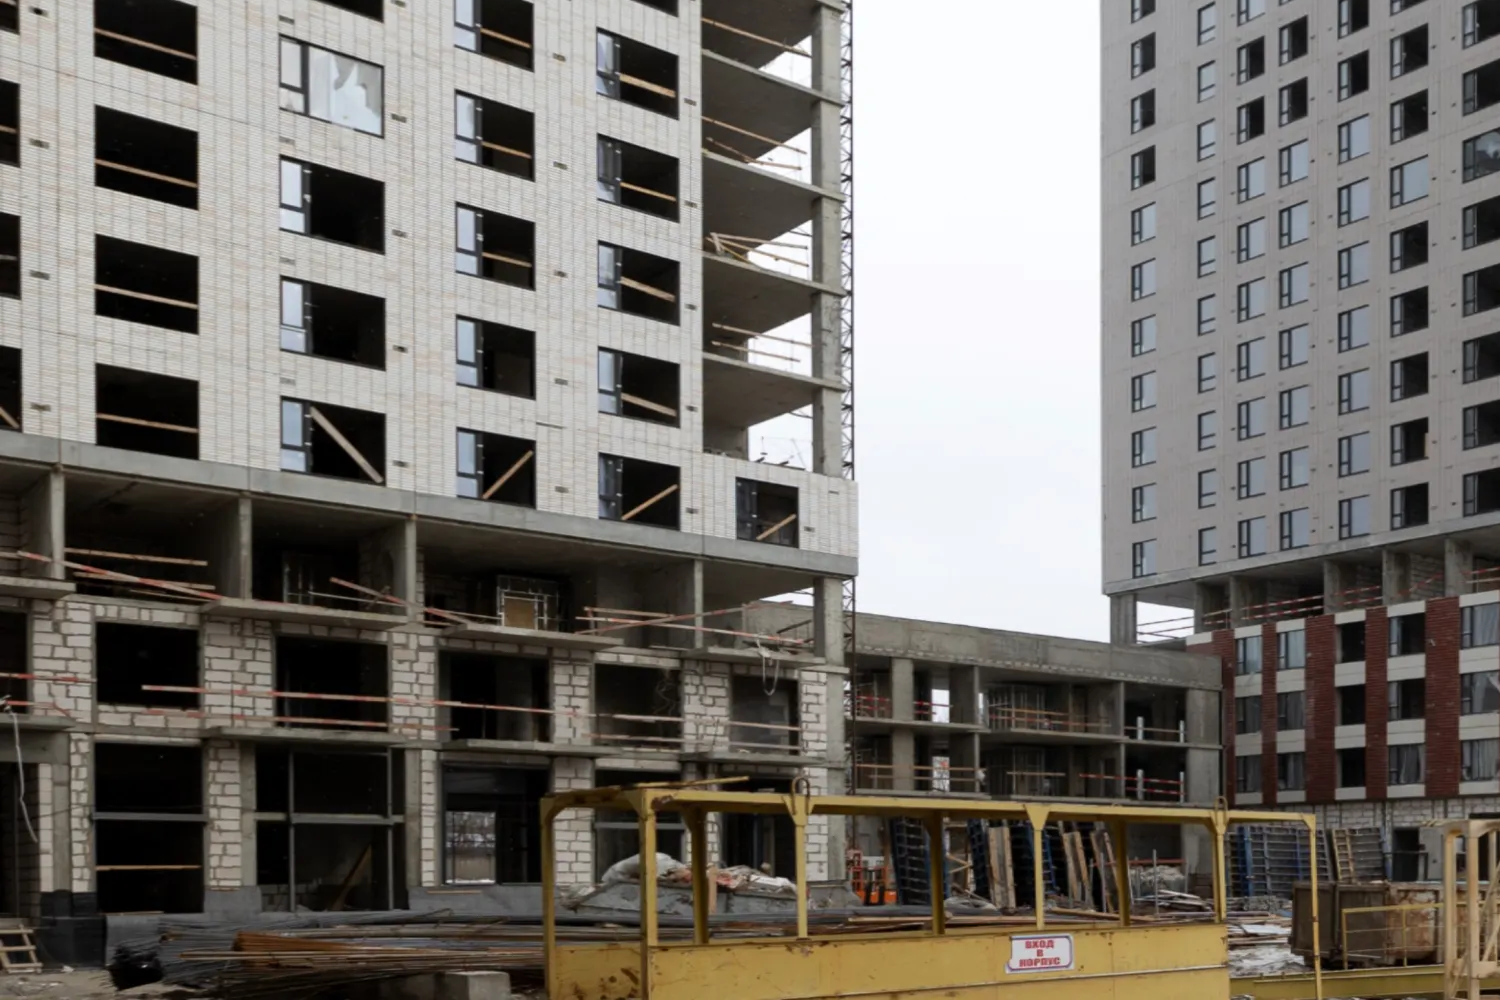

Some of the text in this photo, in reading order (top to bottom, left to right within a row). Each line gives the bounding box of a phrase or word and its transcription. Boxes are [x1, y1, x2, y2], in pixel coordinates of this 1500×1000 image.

[1025, 940, 1054, 949] ВХОД
[1036, 949, 1044, 957] В
[1019, 957, 1060, 967] КОРПУС
